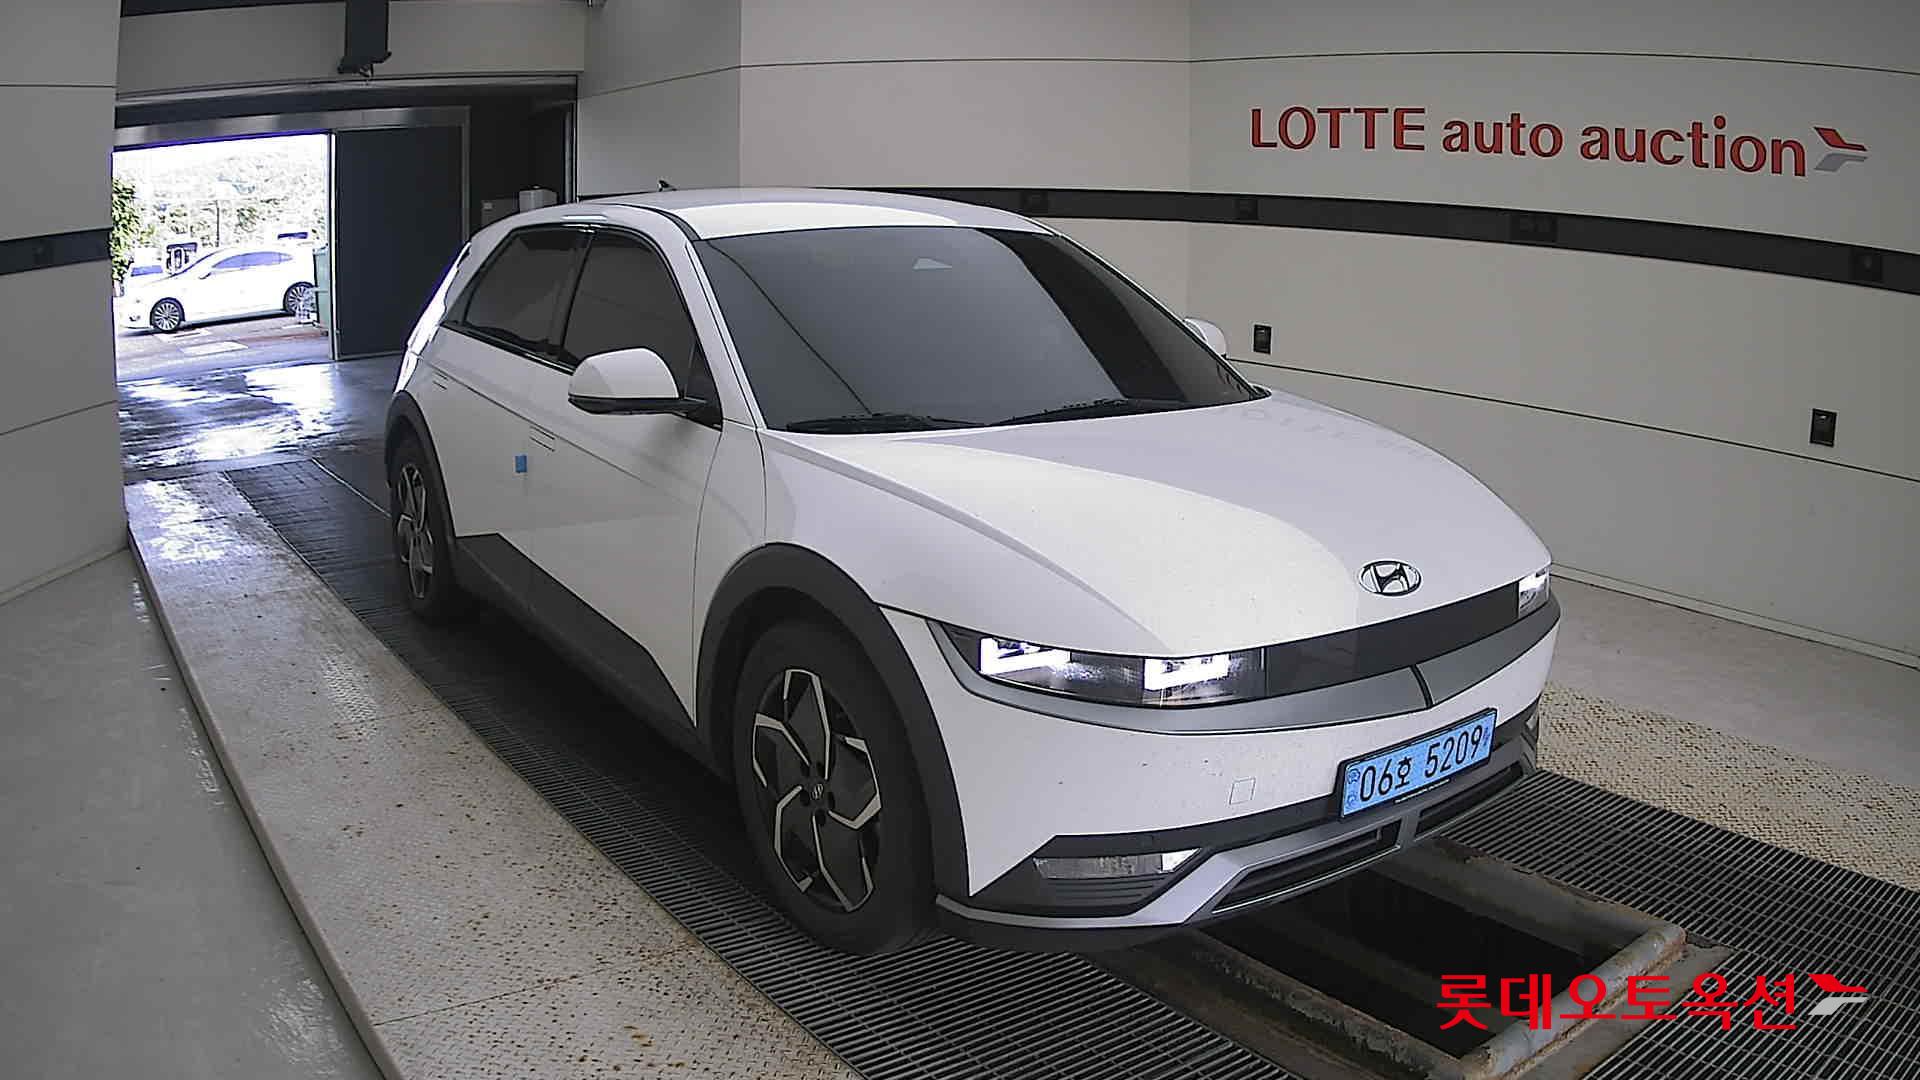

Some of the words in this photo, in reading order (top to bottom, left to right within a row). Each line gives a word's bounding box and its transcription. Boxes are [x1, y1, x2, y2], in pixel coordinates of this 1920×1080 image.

[1252, 107, 1426, 150] LOTTE
[1443, 113, 1563, 156] auto
[1581, 116, 1807, 176] auction
[1360, 757, 1412, 802] 06호
[1425, 725, 1483, 778] 5209
